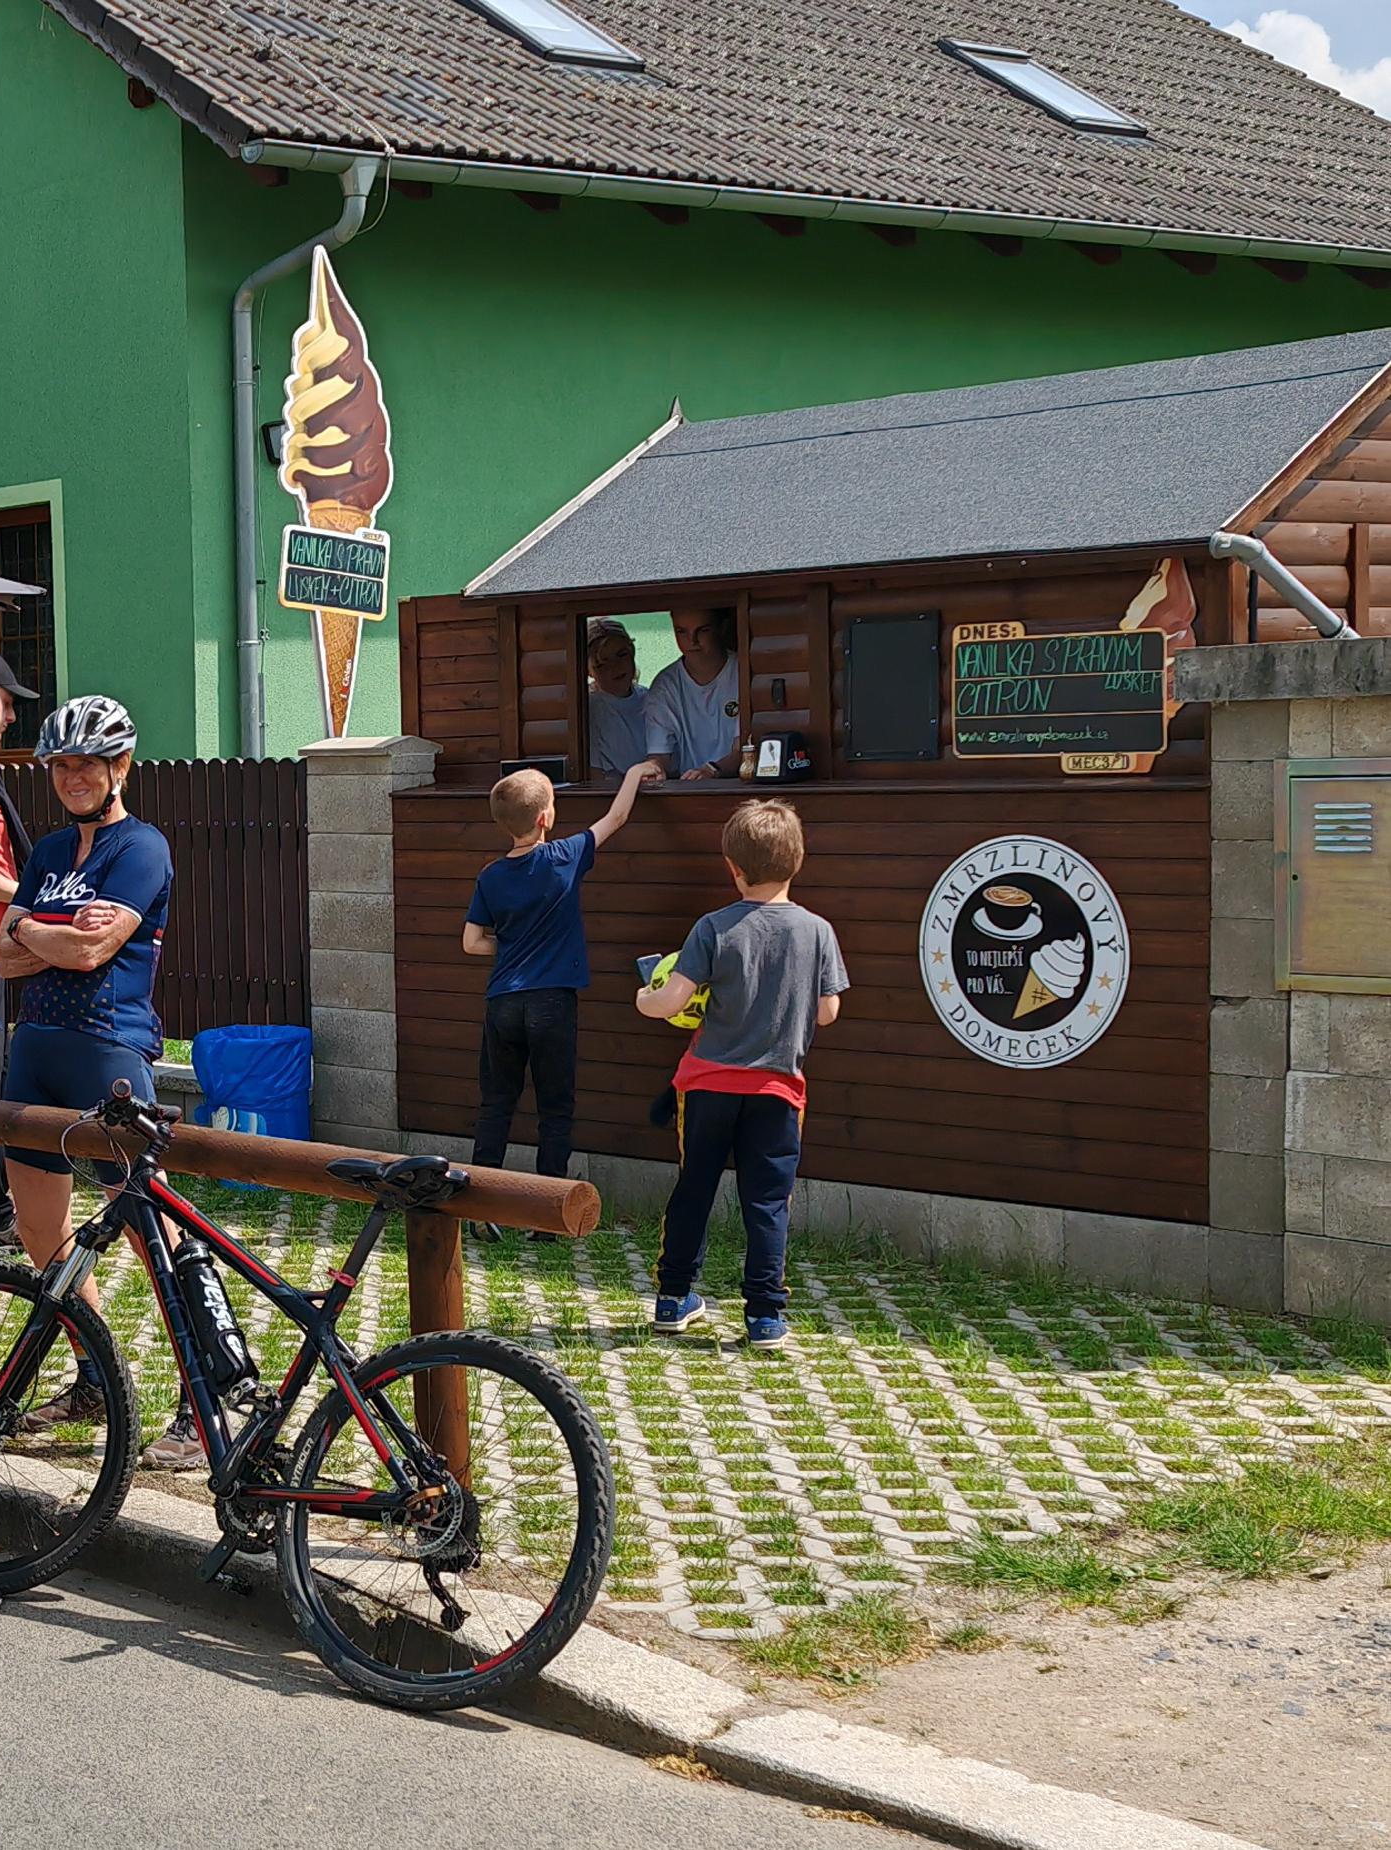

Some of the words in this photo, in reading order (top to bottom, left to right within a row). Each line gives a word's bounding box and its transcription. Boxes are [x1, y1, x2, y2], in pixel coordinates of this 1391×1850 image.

[291, 533, 333, 567] VANILKA
[336, 542, 344, 570] S
[339, 576, 381, 608] CITRON
[957, 641, 1034, 679] VANILKA
[1042, 638, 1060, 673] S
[957, 679, 1054, 716] CITRON
[931, 845, 1125, 954] ZMRZLINOVÝ
[966, 950, 978, 967] TO
[980, 944, 1024, 969] NEJLEPŠÍ
[966, 977, 984, 994] PRO
[948, 1003, 1081, 1059] DOMEČEK
